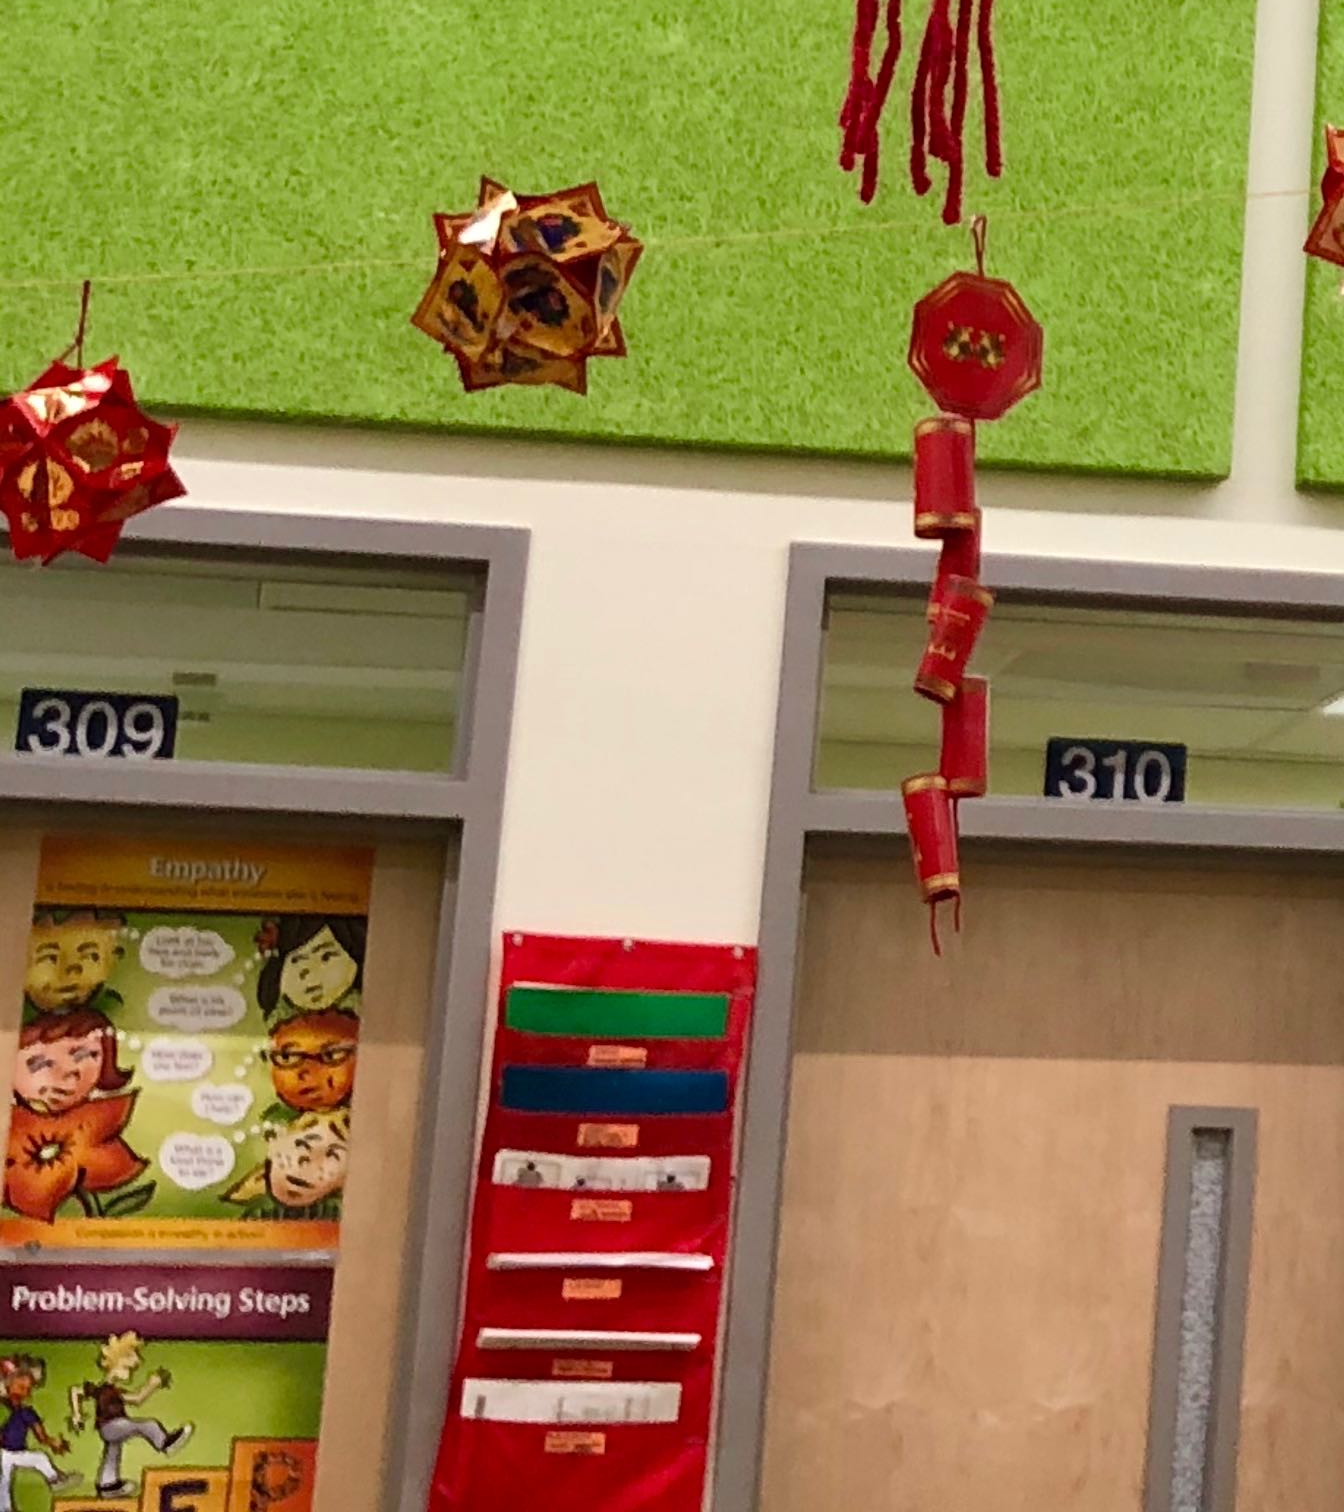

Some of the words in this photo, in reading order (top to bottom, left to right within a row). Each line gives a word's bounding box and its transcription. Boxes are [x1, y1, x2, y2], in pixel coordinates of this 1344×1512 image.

[27, 698, 164, 756] 309
[1058, 745, 1172, 803] 310
[150, 857, 267, 885] Empathy
[12, 1284, 231, 1318] Problem-Solving
[239, 1288, 311, 1319] Steps
